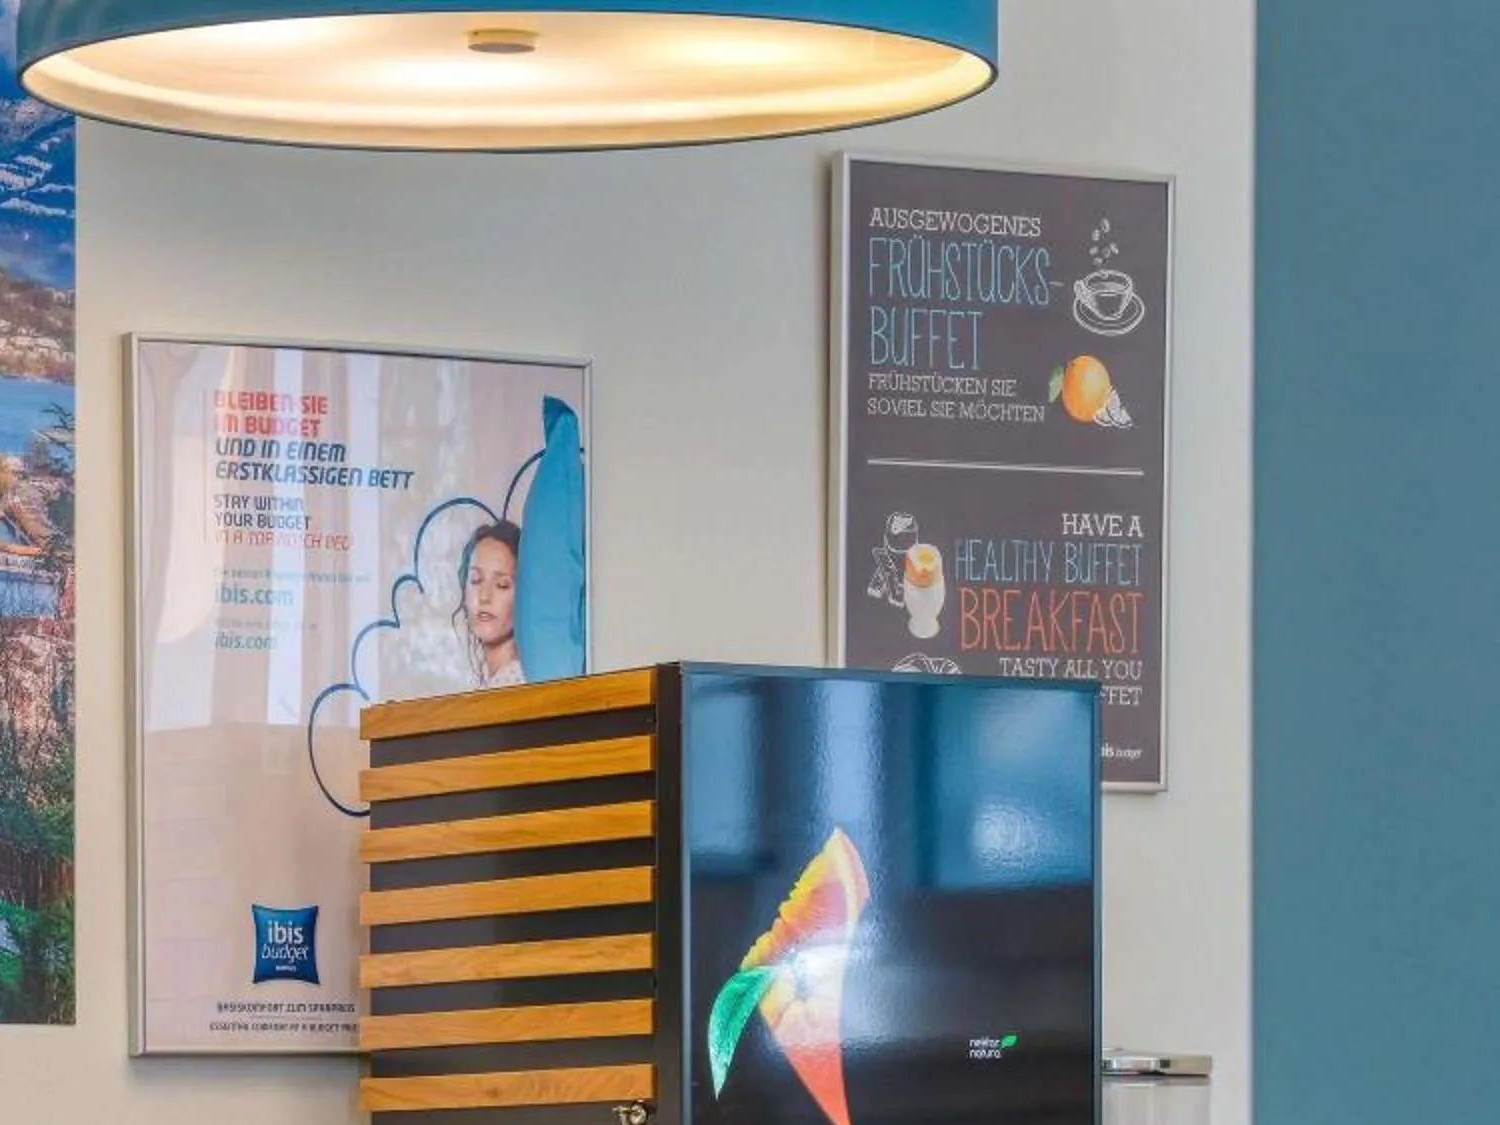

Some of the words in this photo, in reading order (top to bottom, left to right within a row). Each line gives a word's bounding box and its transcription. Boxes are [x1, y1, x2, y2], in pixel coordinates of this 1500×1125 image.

[869, 207, 1041, 237] AUSGEWOGENES
[869, 234, 1063, 305] FRÜHSTÜCKS-
[870, 306, 983, 370] BUFFET
[868, 371, 987, 395] FRÜHSTÜCKEN
[991, 379, 1017, 397] SIE
[300, 394, 328, 415] SIE
[867, 397, 926, 417] SOVIEL
[929, 400, 954, 419] SIE
[959, 401, 1045, 423] MÖCHTEN
[245, 415, 321, 437] BUDGET
[216, 437, 255, 457] UND
[261, 439, 280, 459] IN
[287, 441, 347, 463] EINEM
[216, 460, 361, 487] ERSTKLASSIGEN
[367, 467, 414, 489] BETT
[213, 494, 250, 509] STAY
[214, 512, 253, 527] YOUR
[257, 513, 311, 530] BUDGET
[1061, 513, 1123, 537] HAVE
[1127, 515, 1143, 537] A
[955, 539, 1053, 584] HEALTHY
[1064, 541, 1142, 586] BUFFET
[959, 587, 1143, 654] BREAKFAST
[999, 657, 1059, 677] TASTY
[1065, 659, 1097, 678] ALL
[1102, 660, 1143, 680] YOU
[267, 920, 304, 945] ibis
[261, 943, 309, 965] budget
